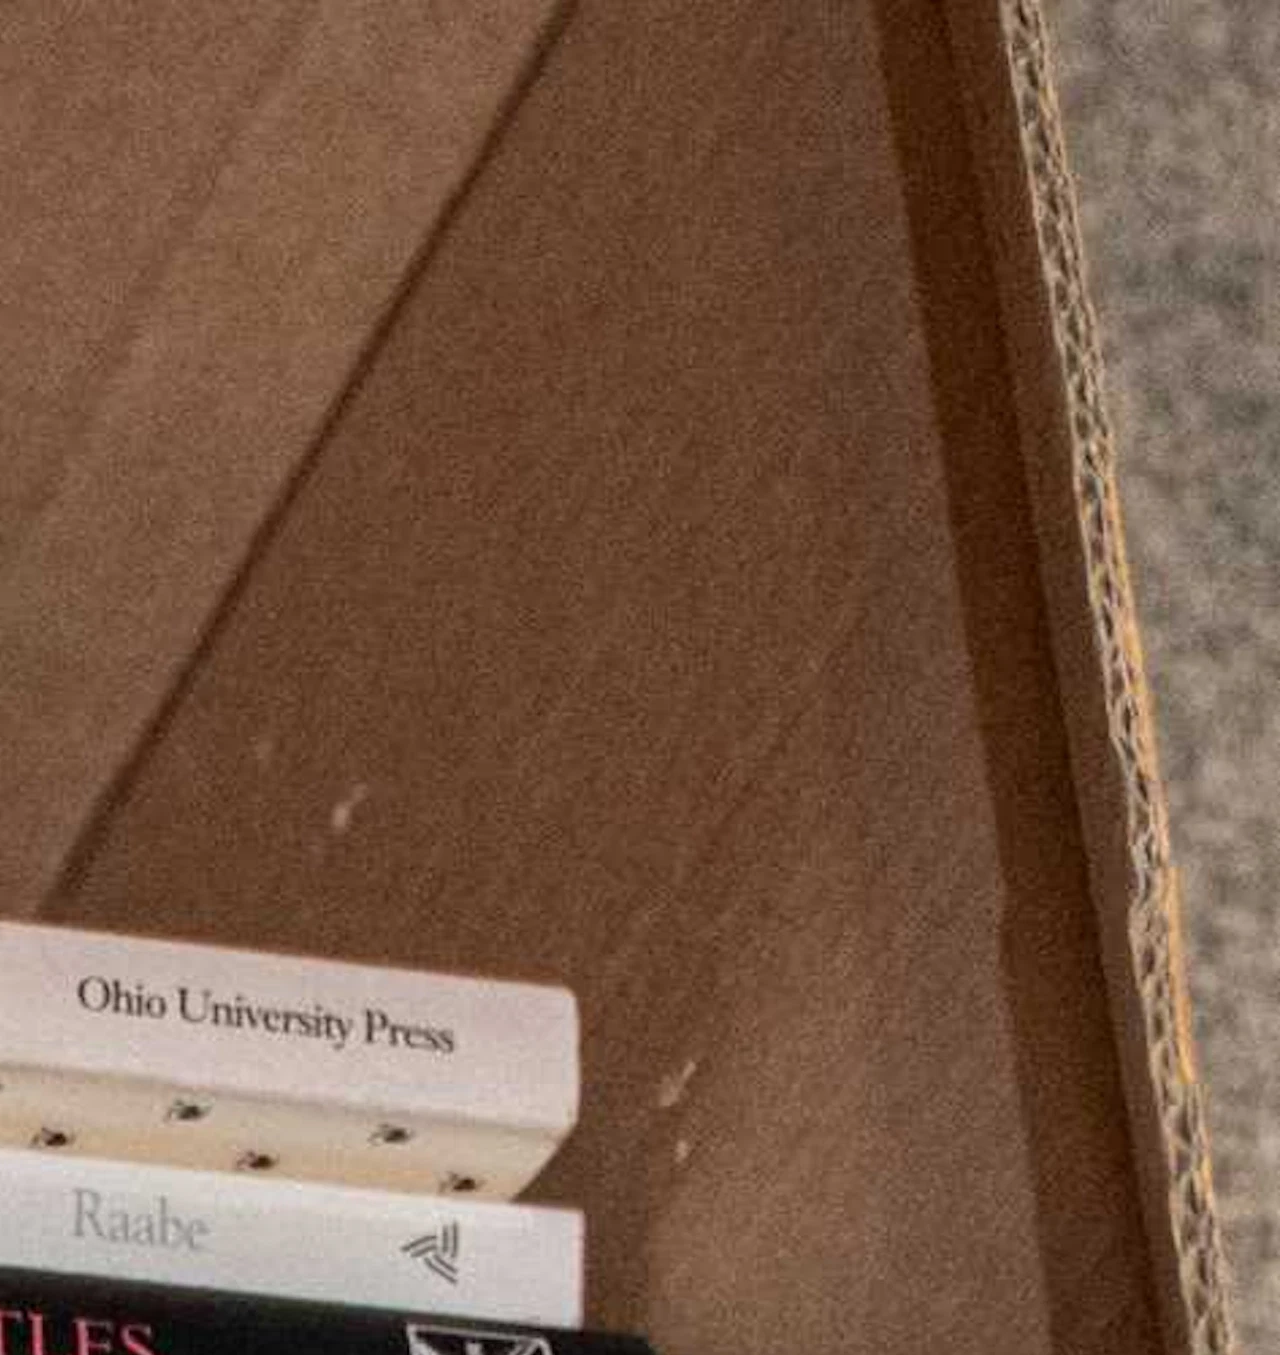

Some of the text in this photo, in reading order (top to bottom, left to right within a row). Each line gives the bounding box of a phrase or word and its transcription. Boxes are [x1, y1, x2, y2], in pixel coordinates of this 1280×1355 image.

[76, 975, 457, 1054] Ohio University Press
[72, 1186, 211, 1254] Raabe
